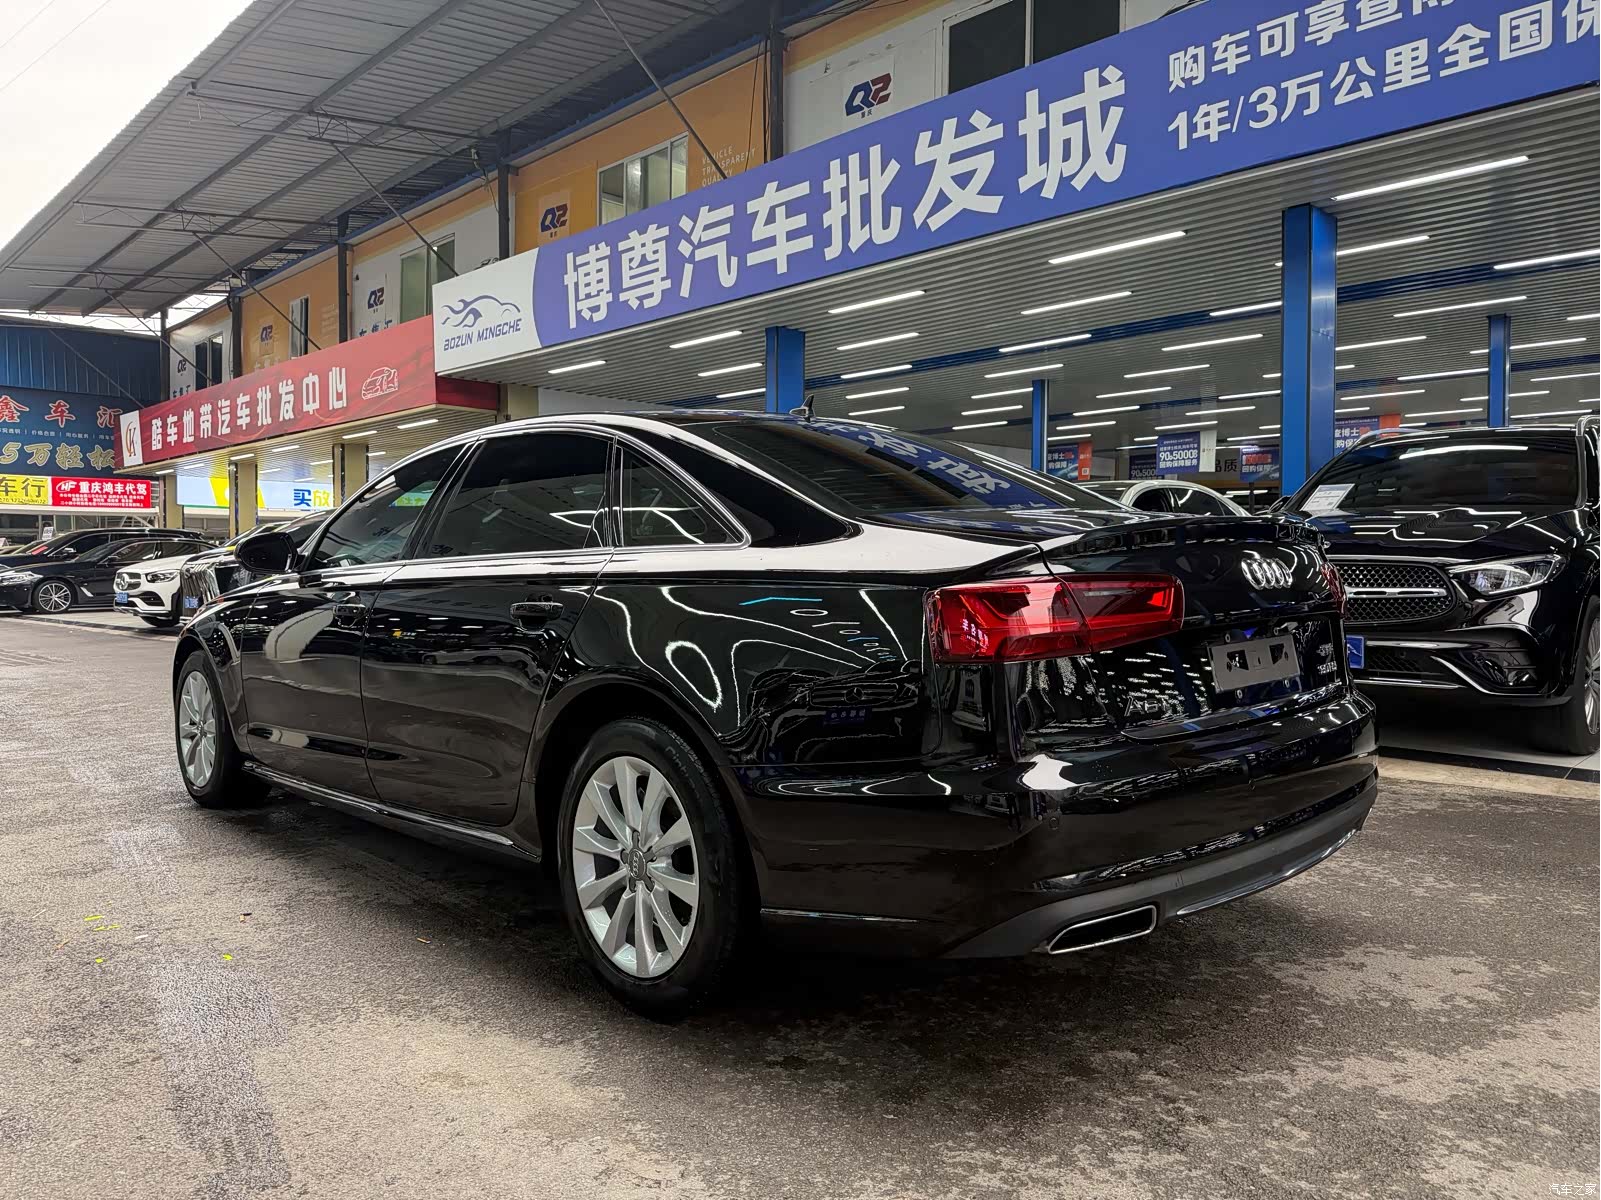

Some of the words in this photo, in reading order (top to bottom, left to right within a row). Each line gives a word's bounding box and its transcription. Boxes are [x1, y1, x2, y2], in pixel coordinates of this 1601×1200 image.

[702, 148, 756, 175] TRASPARENT
[702, 168, 733, 188] QUALTY
[563, 64, 1128, 330] 博尊汽车批发城
[443, 331, 474, 352] BOZUN
[477, 318, 522, 343] MINGCHE
[151, 366, 348, 451] 酷车地带汽车批发中心
[79, 481, 147, 496] 重庆鸿丰代驾
